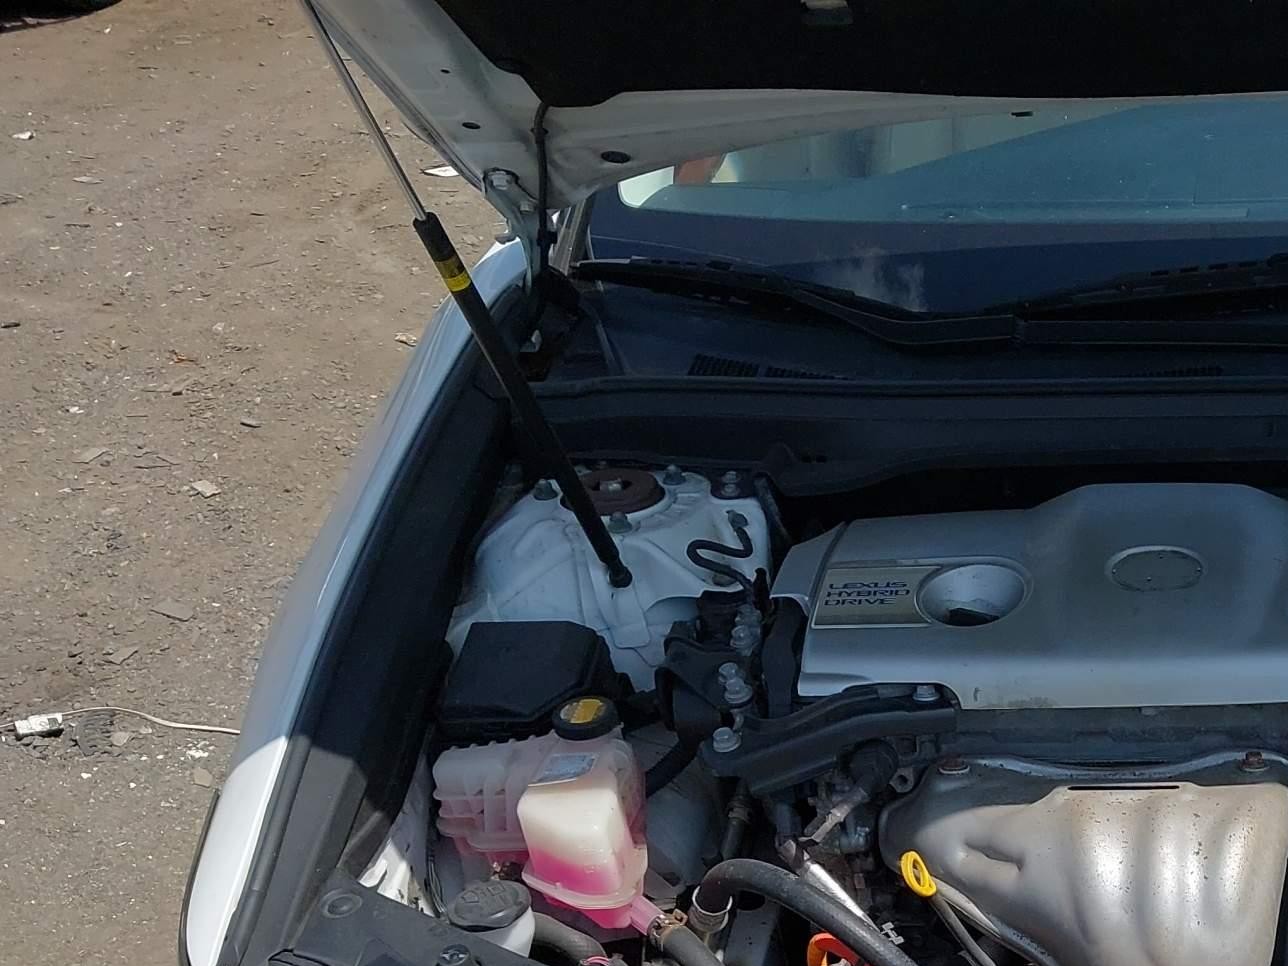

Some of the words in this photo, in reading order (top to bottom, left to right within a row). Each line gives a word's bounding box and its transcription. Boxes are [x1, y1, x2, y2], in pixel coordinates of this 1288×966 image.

[829, 581, 907, 589] LEXUS
[827, 589, 911, 597] HYBRID
[824, 597, 897, 606] DRIVE
